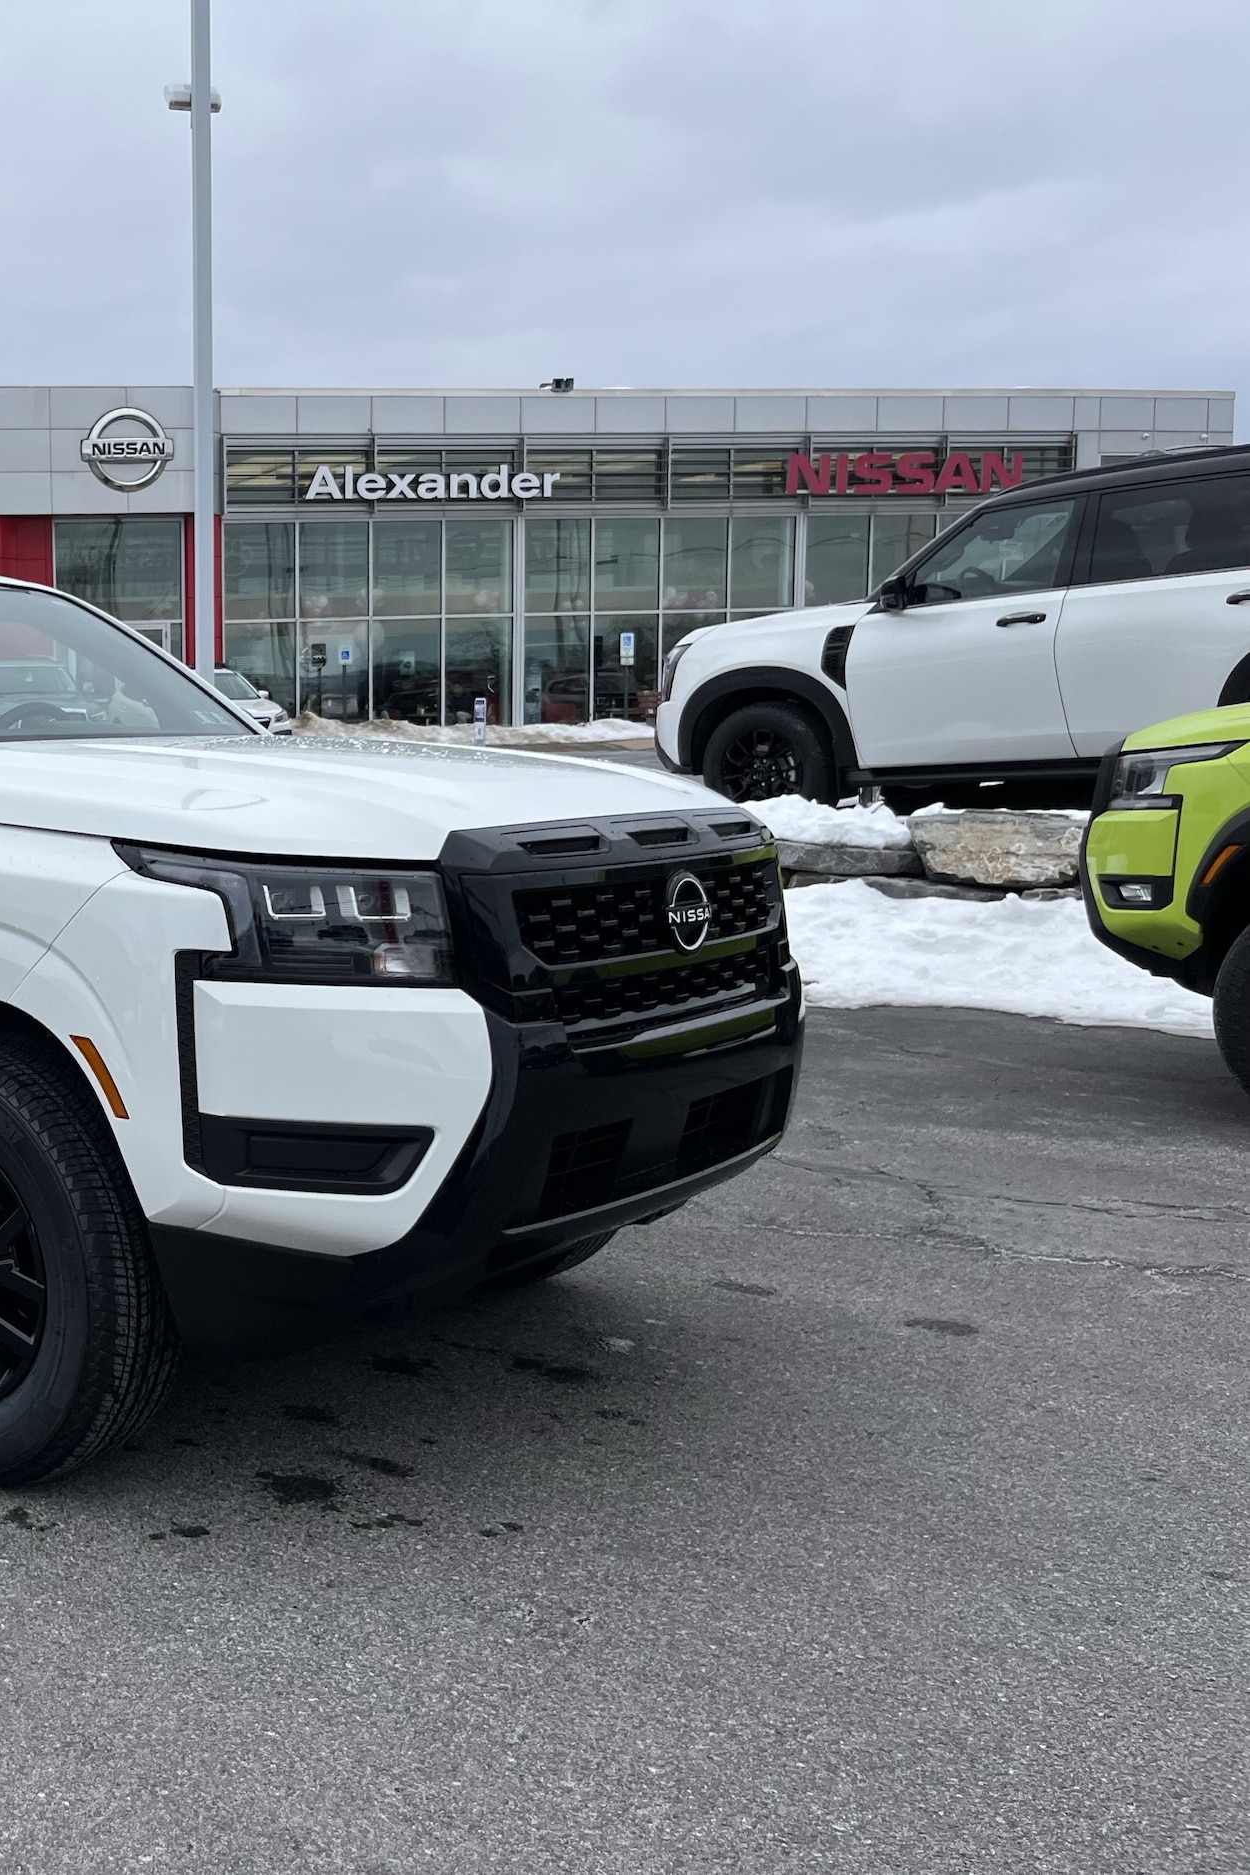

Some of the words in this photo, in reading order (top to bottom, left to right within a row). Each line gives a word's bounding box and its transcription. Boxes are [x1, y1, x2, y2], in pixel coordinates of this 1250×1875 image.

[92, 442, 165, 456] NISSAN
[305, 464, 561, 500] Alexander
[785, 453, 1024, 495] NISSAN
[668, 907, 711, 924] NISSA
